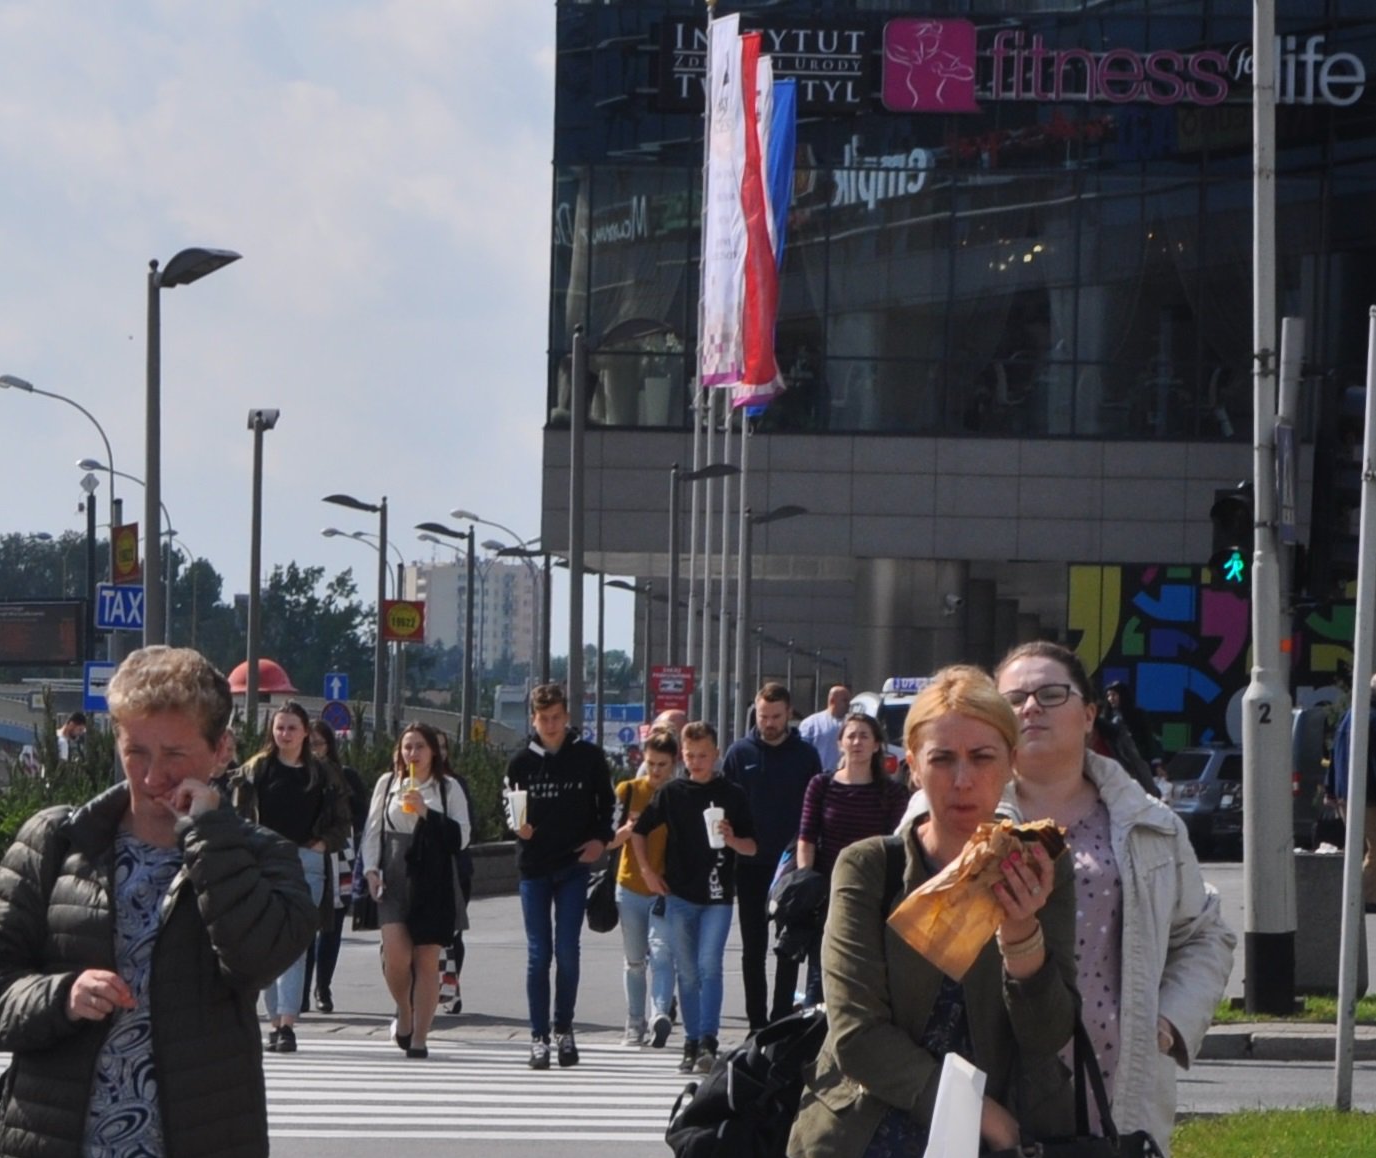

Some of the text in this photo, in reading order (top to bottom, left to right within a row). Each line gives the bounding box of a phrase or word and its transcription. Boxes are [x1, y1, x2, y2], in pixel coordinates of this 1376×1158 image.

[991, 30, 1229, 106] fitness
[102, 590, 143, 624] TAX
[1258, 703, 1272, 724] 2
